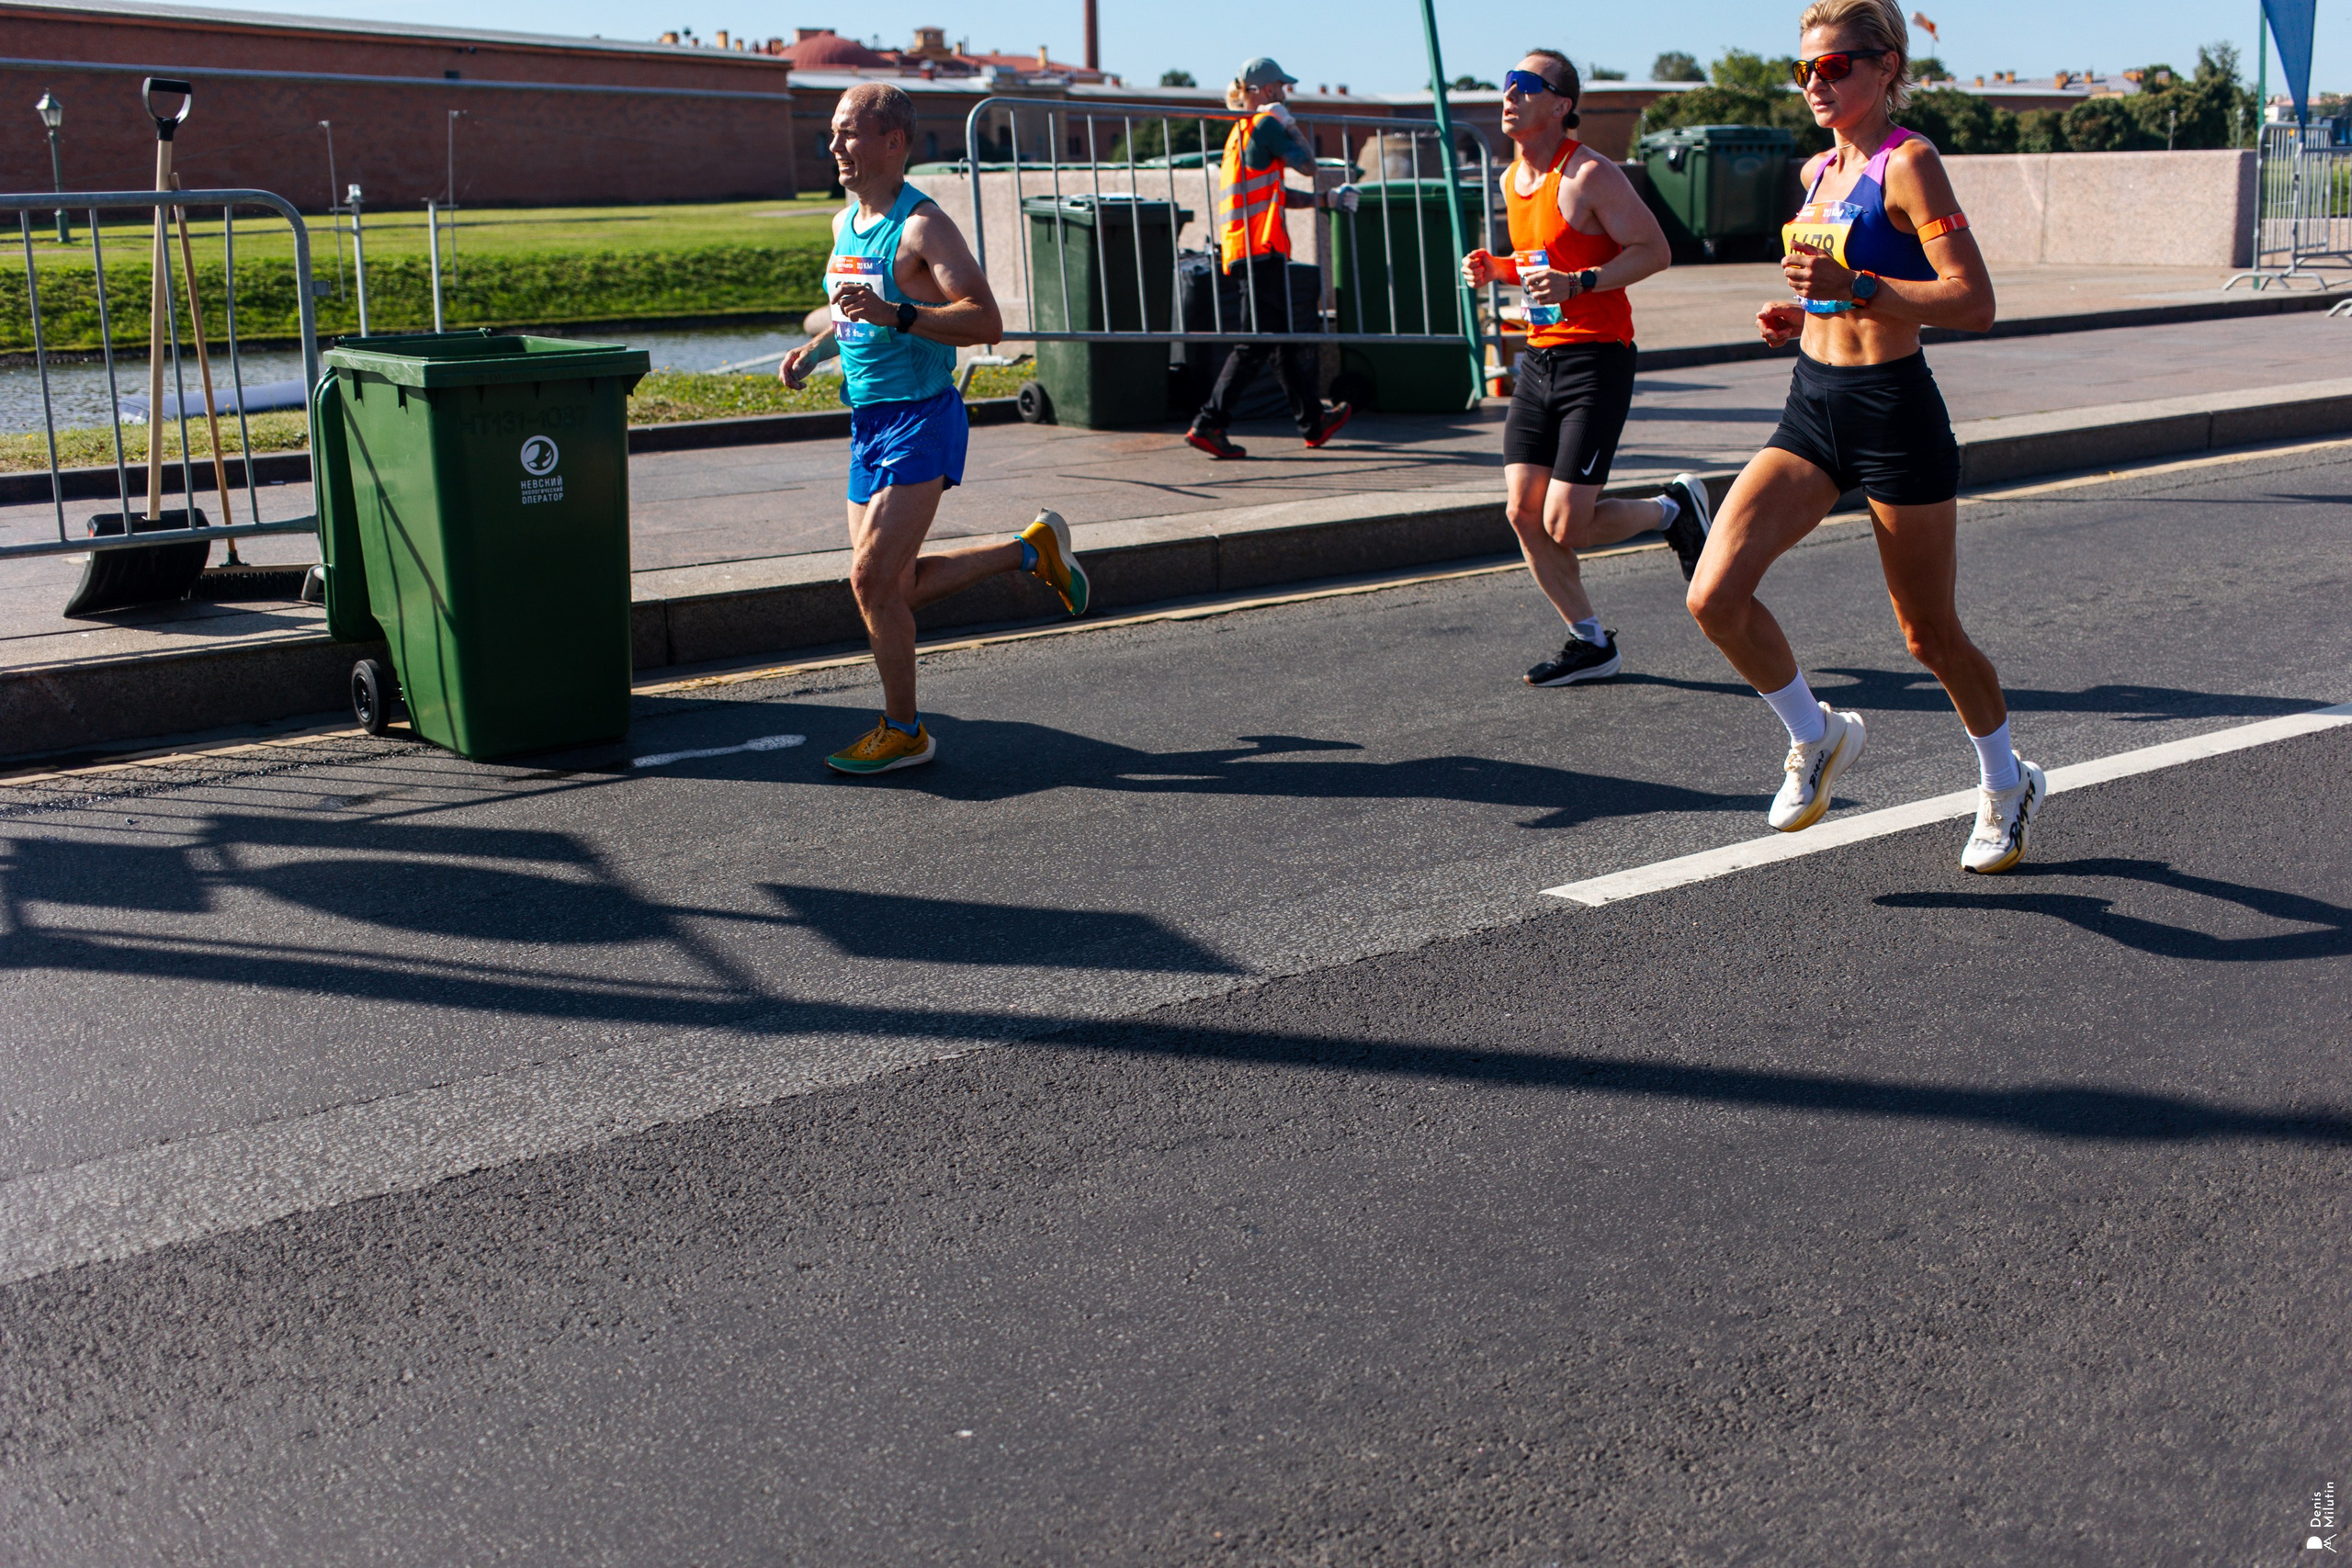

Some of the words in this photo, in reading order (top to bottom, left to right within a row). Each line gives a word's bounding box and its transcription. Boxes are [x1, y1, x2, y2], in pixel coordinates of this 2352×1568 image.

[836, 323, 842, 338] A
[520, 475, 563, 490] НЕВСКИЙ
[521, 486, 563, 496] ЭКОЛОГИЧЕСКИЙ
[521, 492, 564, 505] ОПЕРАТОР
